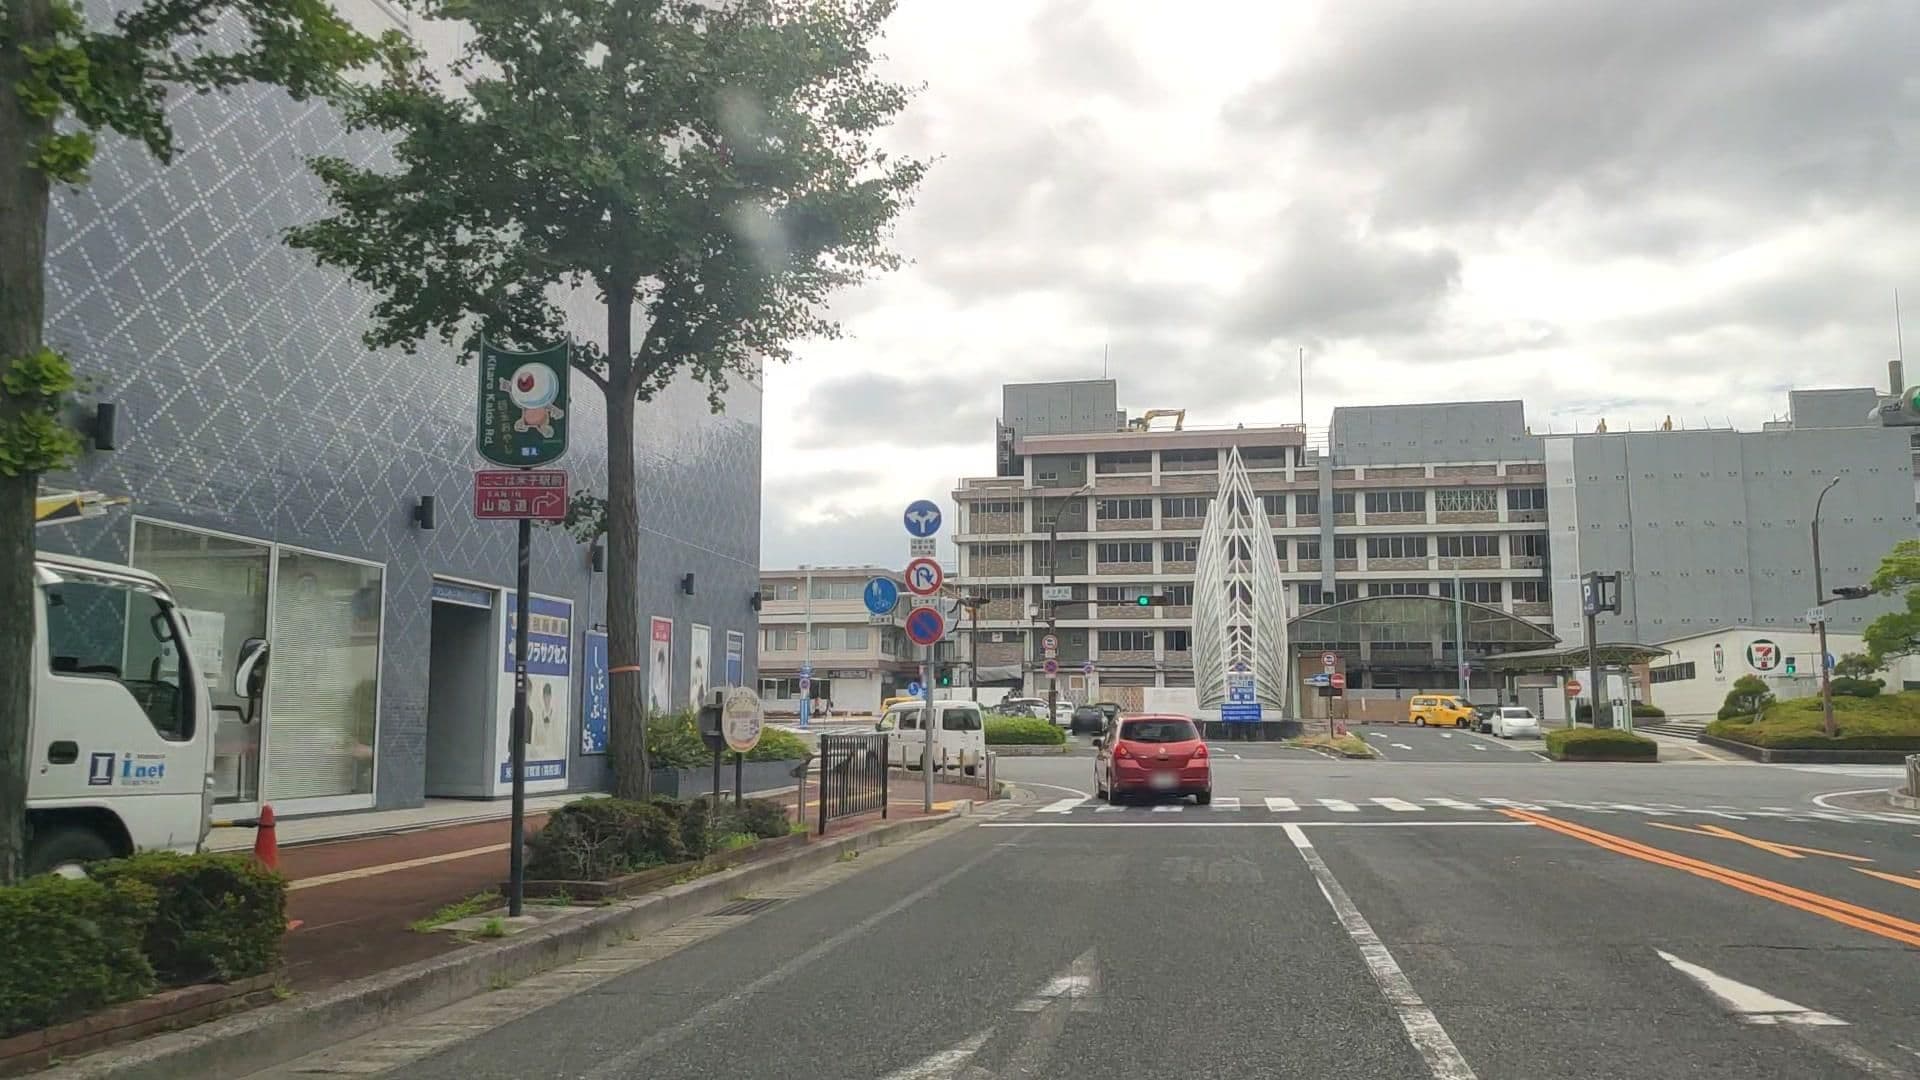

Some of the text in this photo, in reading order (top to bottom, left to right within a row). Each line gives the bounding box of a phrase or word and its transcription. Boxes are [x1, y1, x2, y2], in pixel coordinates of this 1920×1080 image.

[486, 355, 497, 389] Kitaro
[485, 394, 496, 425] Kaido
[1583, 585, 1591, 602] P
[527, 642, 568, 664] クラサクセス
